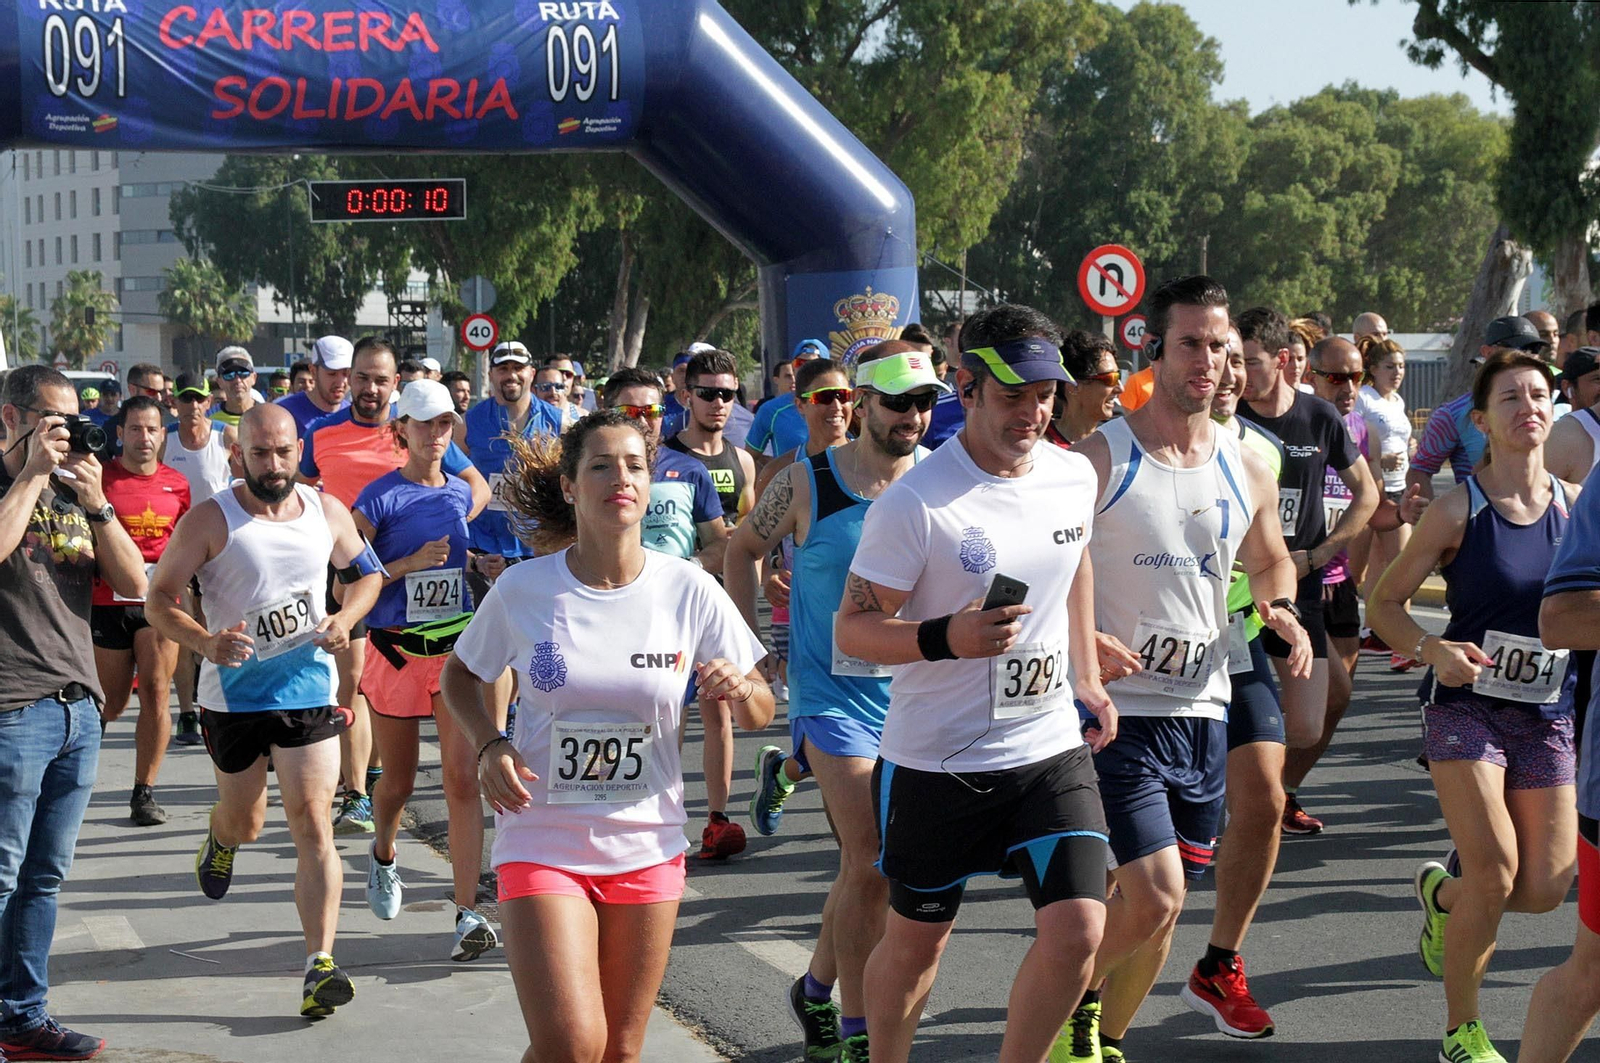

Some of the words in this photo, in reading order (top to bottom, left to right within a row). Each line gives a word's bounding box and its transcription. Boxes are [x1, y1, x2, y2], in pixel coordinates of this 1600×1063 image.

[538, 1, 620, 21] RUTA
[158, 5, 440, 53] CARRERA
[44, 13, 125, 98] 091
[546, 23, 619, 102] 091
[210, 75, 519, 122] SOLIDARIA
[469, 326, 491, 339] 40
[1127, 325, 1146, 338] 40
[843, 340, 866, 365] OLICIA
[1053, 526, 1084, 546] CNP
[1133, 552, 1200, 570] Golfitness
[413, 578, 459, 607] 4224
[257, 599, 309, 643] 4059
[630, 653, 677, 669] CNP
[1138, 633, 1206, 679] 4219
[1486, 645, 1556, 685] 4054
[1004, 649, 1063, 698] 3292
[558, 736, 643, 781] 3295
[606, 783, 648, 792] DEPORTIVA
